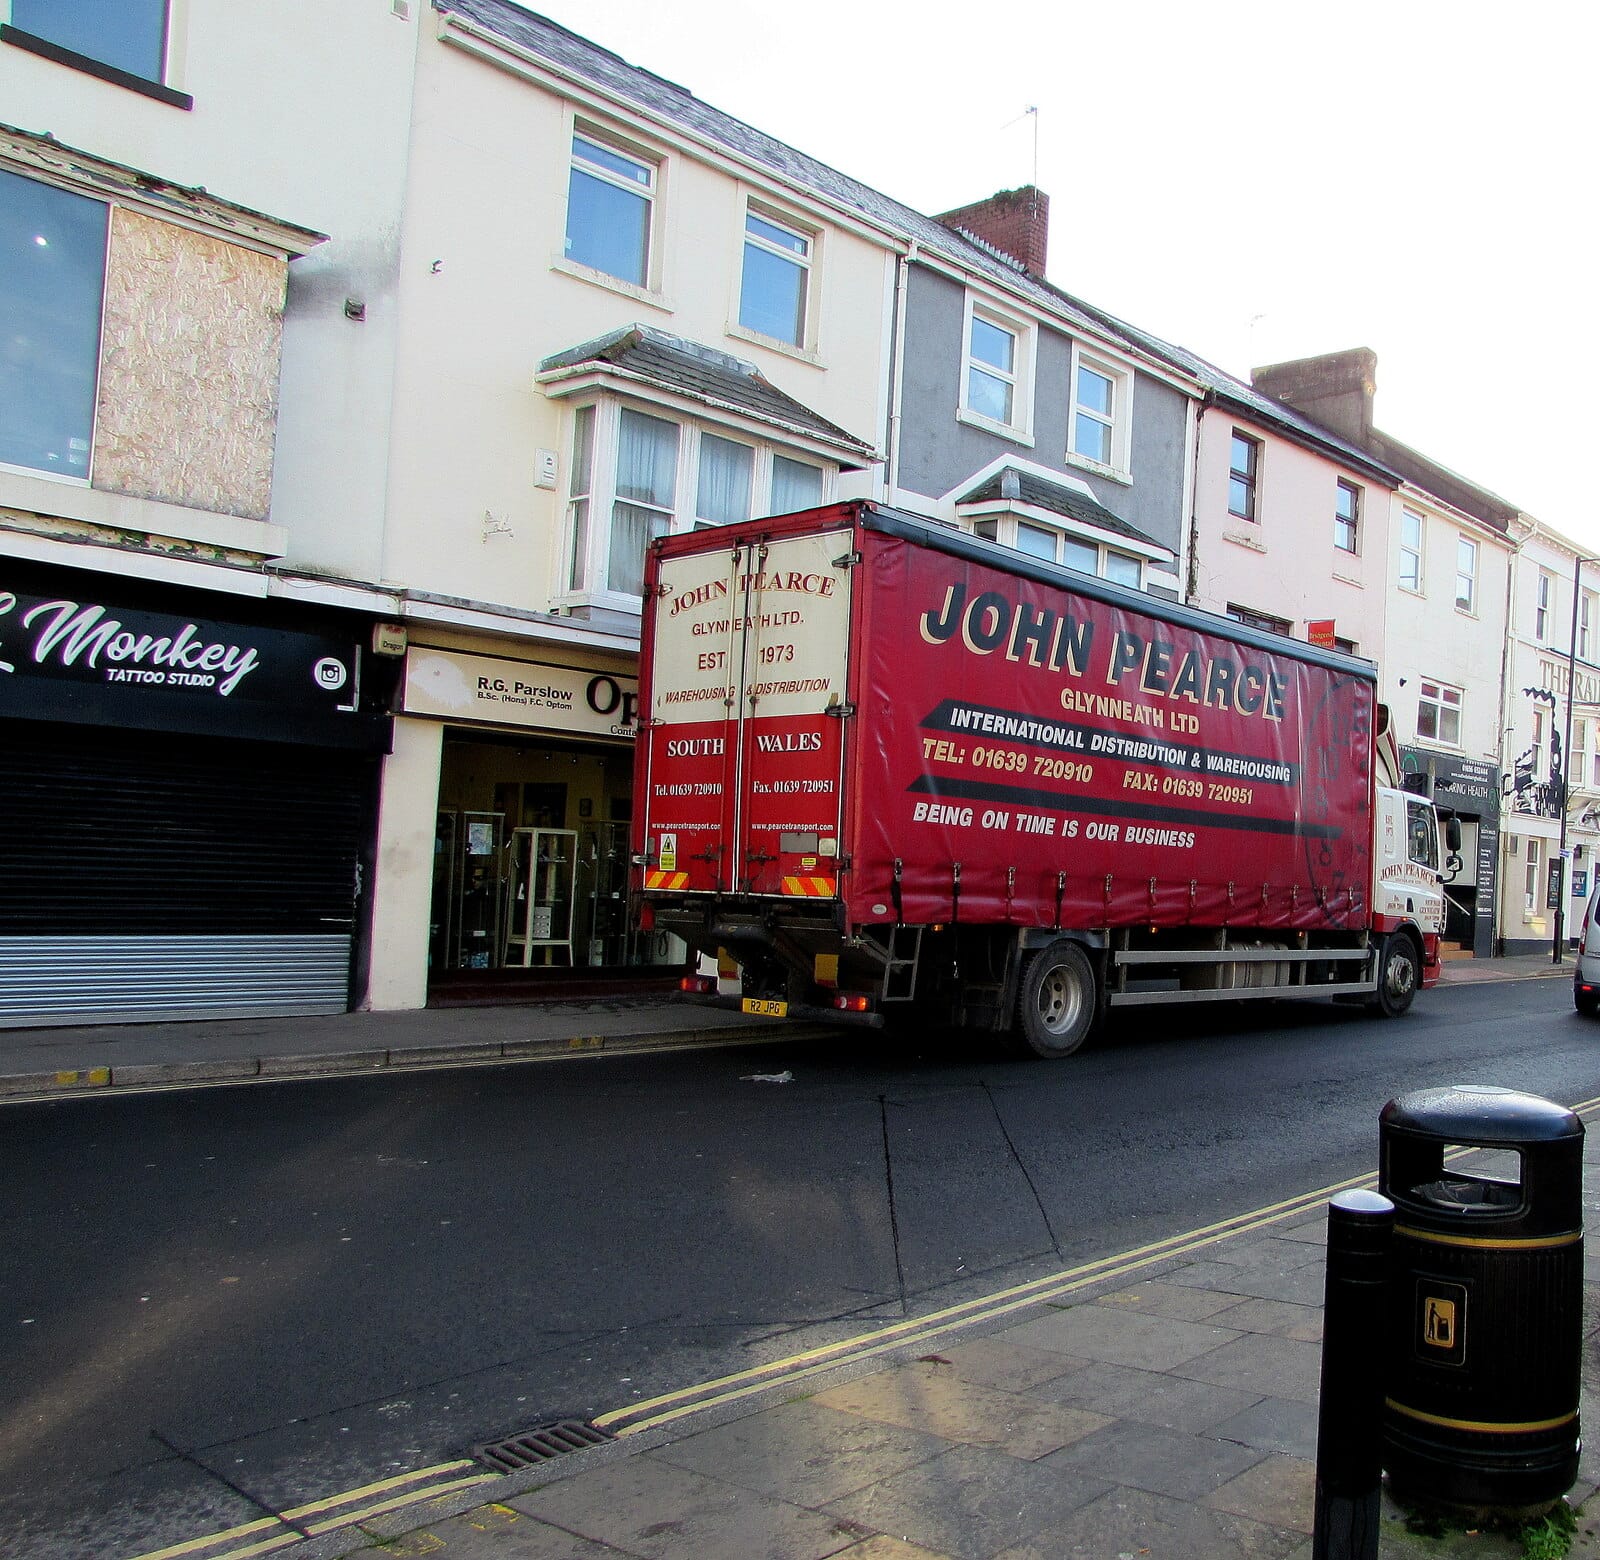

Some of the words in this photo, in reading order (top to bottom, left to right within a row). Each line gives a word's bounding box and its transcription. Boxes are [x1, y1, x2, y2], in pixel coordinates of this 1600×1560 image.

[670, 578, 729, 618] JOHN
[738, 571, 837, 599] PEARCE
[692, 614, 771, 636] GLYNNEAH
[774, 611, 804, 626] LTD.
[23, 600, 260, 697] Monkey
[760, 644, 795, 664] 1973
[919, 582, 1095, 678] JOHN
[1106, 630, 1290, 722] PEARCE
[107, 669, 165, 685] TATTOO
[167, 673, 216, 688] STUDIO
[477, 677, 509, 693] R.G.
[514, 682, 573, 702] Parslow
[665, 686, 736, 704] WAREHOUSING
[746, 684, 753, 696] &
[755, 678, 831, 696] DISTRIBUTION
[1574, 670, 1600, 703] RAI
[477, 692, 499, 701] B.Sc.
[501, 694, 528, 705] (Hons)
[546, 700, 573, 711] Optom
[1060, 688, 1164, 728] GLYNNEATH
[1170, 711, 1201, 735] LTD
[667, 738, 724, 757] SOUTH
[757, 732, 822, 752] WALES
[950, 708, 1084, 748] INTERNATIONAL
[1090, 734, 1186, 766] DISTRIBUTION
[1190, 753, 1201, 768] &
[1206, 754, 1291, 782] WAREHOUSING
[922, 738, 965, 764] TEL:
[971, 746, 1027, 773] 01639
[1033, 757, 1094, 783] 720910
[655, 784, 668, 796] Tel.
[669, 783, 692, 796] 01639
[694, 783, 722, 795] 720910
[753, 780, 772, 793] Fax.
[774, 780, 800, 793] 01639
[802, 780, 834, 793] 720951
[1122, 770, 1158, 791] FAX:
[1162, 777, 1203, 799] 01639
[1208, 782, 1254, 805] 720951
[1467, 785, 1488, 799] HEALTH
[752, 822, 834, 831] www.pearcetransport.com
[913, 802, 973, 826] BEING
[981, 809, 1009, 830] ON
[1015, 814, 1055, 836] TIME
[1061, 819, 1079, 838] IS
[1085, 822, 1119, 842] OUR
[1124, 826, 1196, 849] BUSINESS
[1381, 863, 1403, 880] JOHN
[1405, 863, 1435, 887] PEARCE
[750, 1001, 761, 1012] R2
[764, 1002, 780, 1014] JPG
